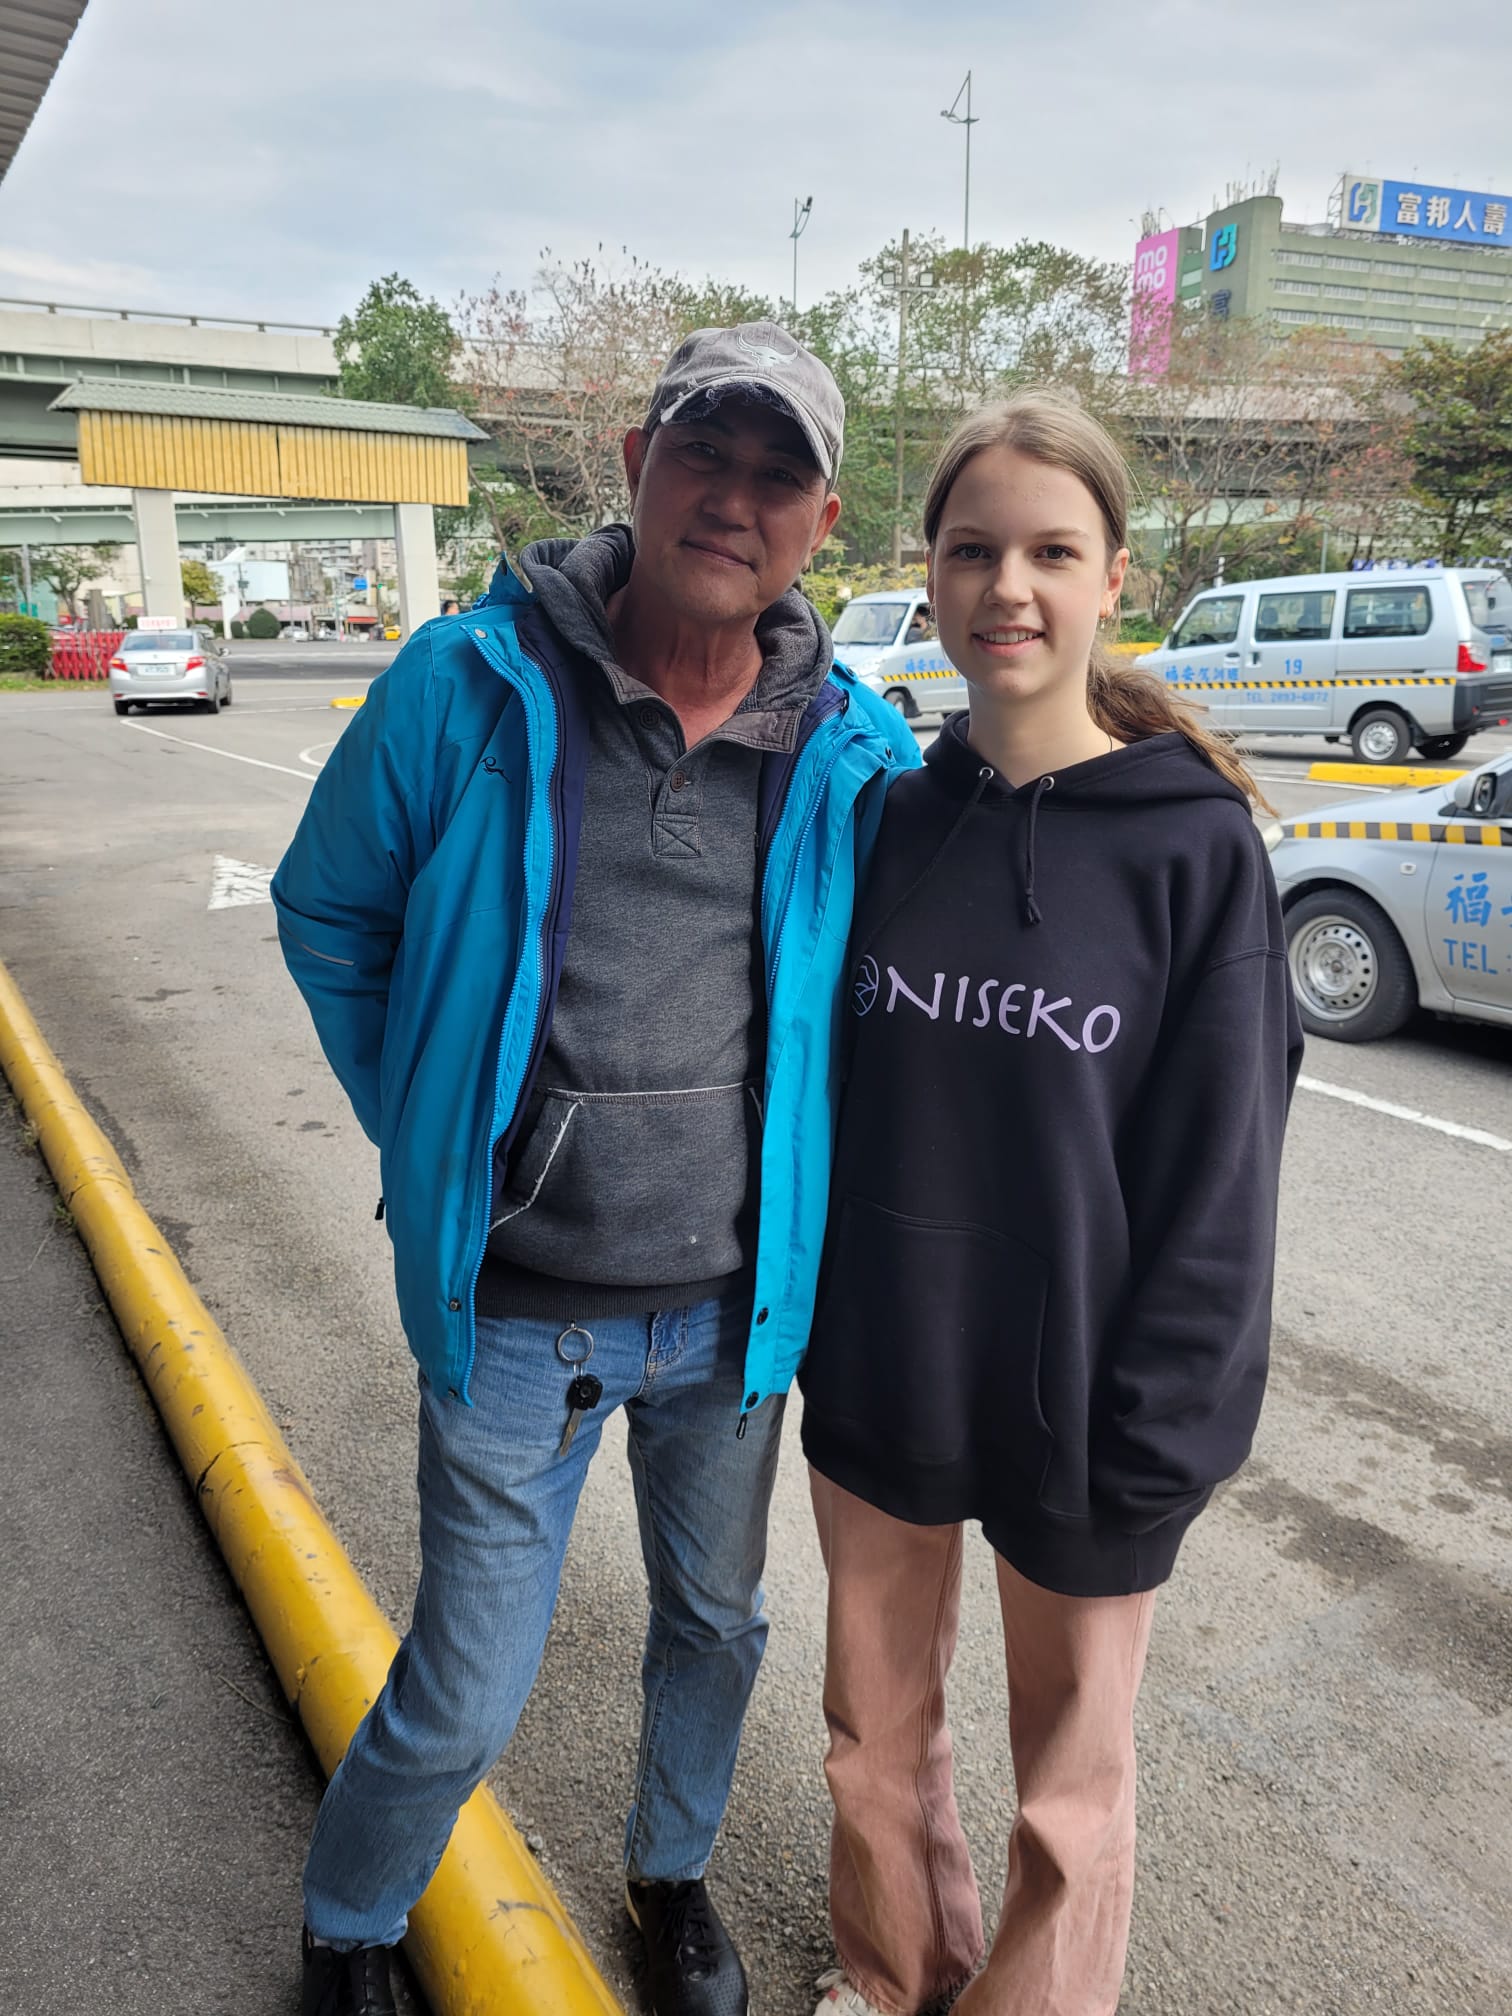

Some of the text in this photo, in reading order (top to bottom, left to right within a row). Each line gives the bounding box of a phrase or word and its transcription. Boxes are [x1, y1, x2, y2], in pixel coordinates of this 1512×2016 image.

[1396, 192, 1507, 236] 富邦人壽
[1285, 658, 1303, 675] 19
[1445, 872, 1512, 928] 福
[886, 966, 1121, 1054] NISEKO
